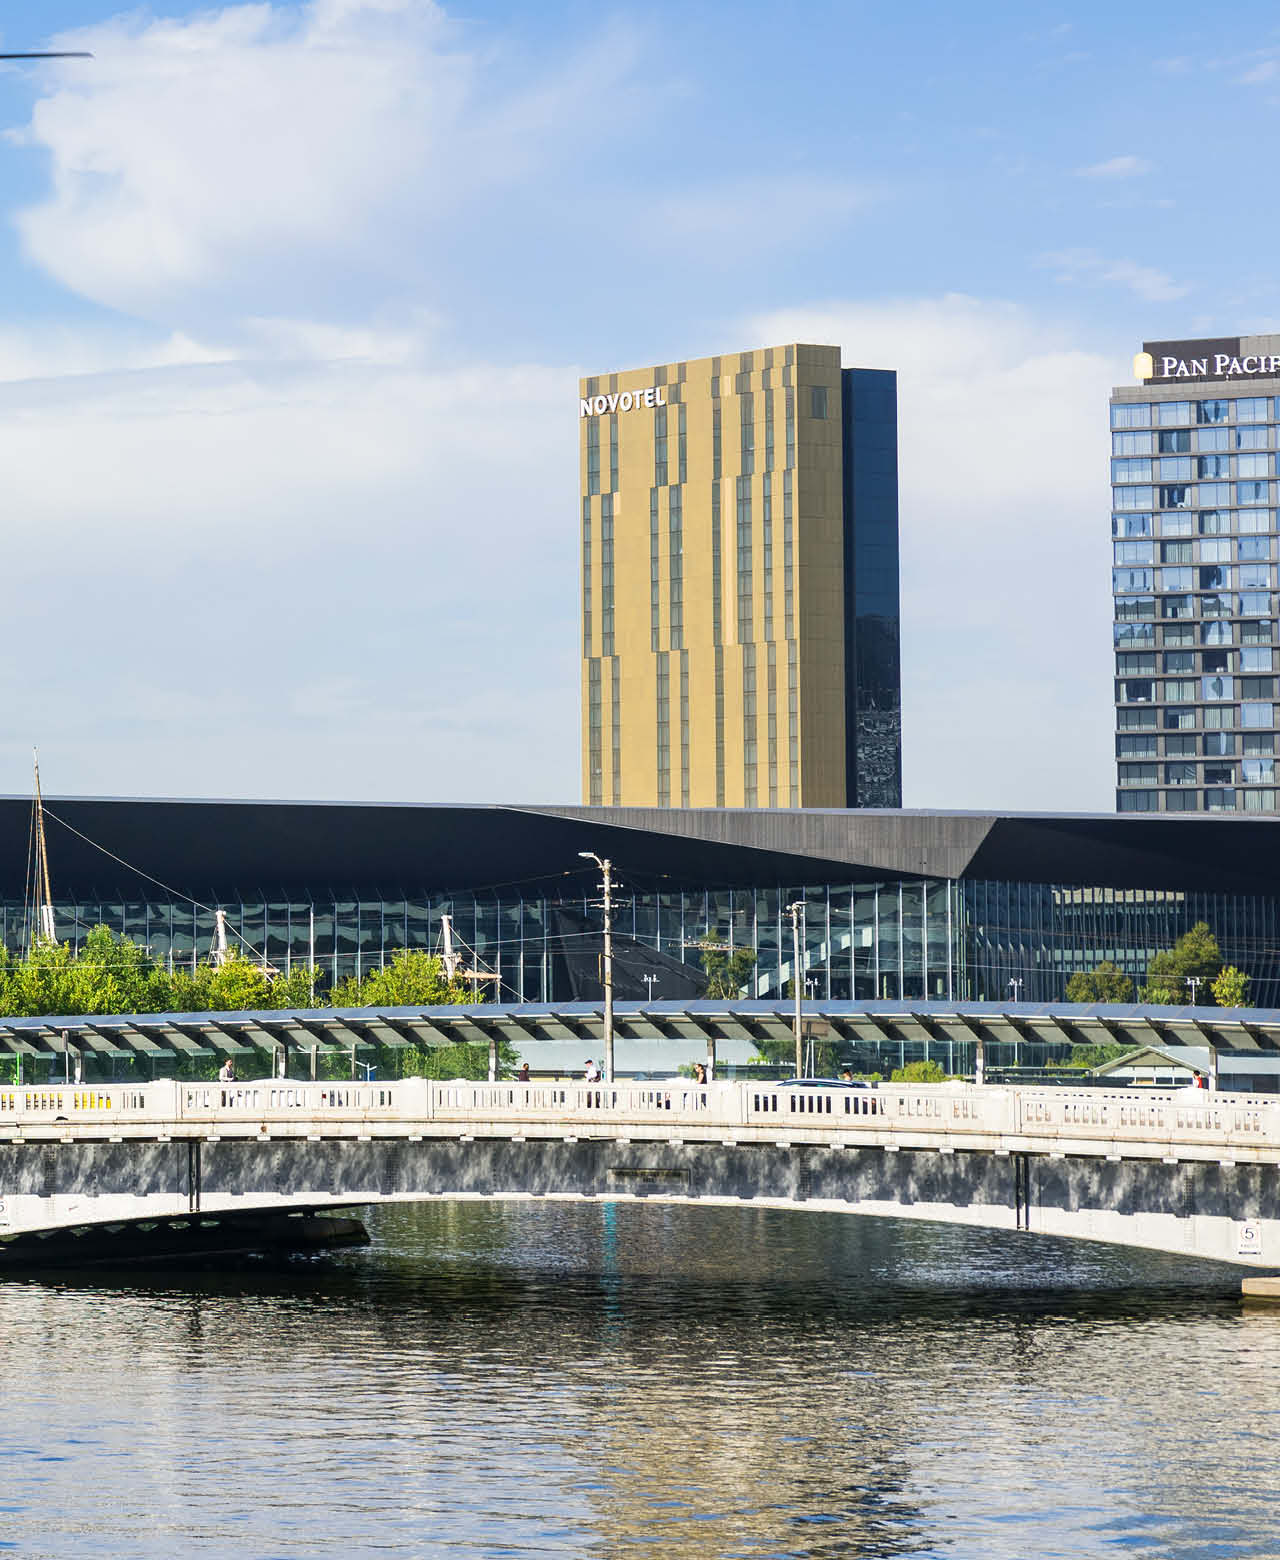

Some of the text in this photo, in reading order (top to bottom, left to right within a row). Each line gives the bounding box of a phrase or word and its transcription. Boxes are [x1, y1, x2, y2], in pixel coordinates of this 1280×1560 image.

[1162, 357, 1208, 377] PAN
[580, 387, 666, 417] NOVOTEL
[1245, 1228, 1254, 1240] 5
